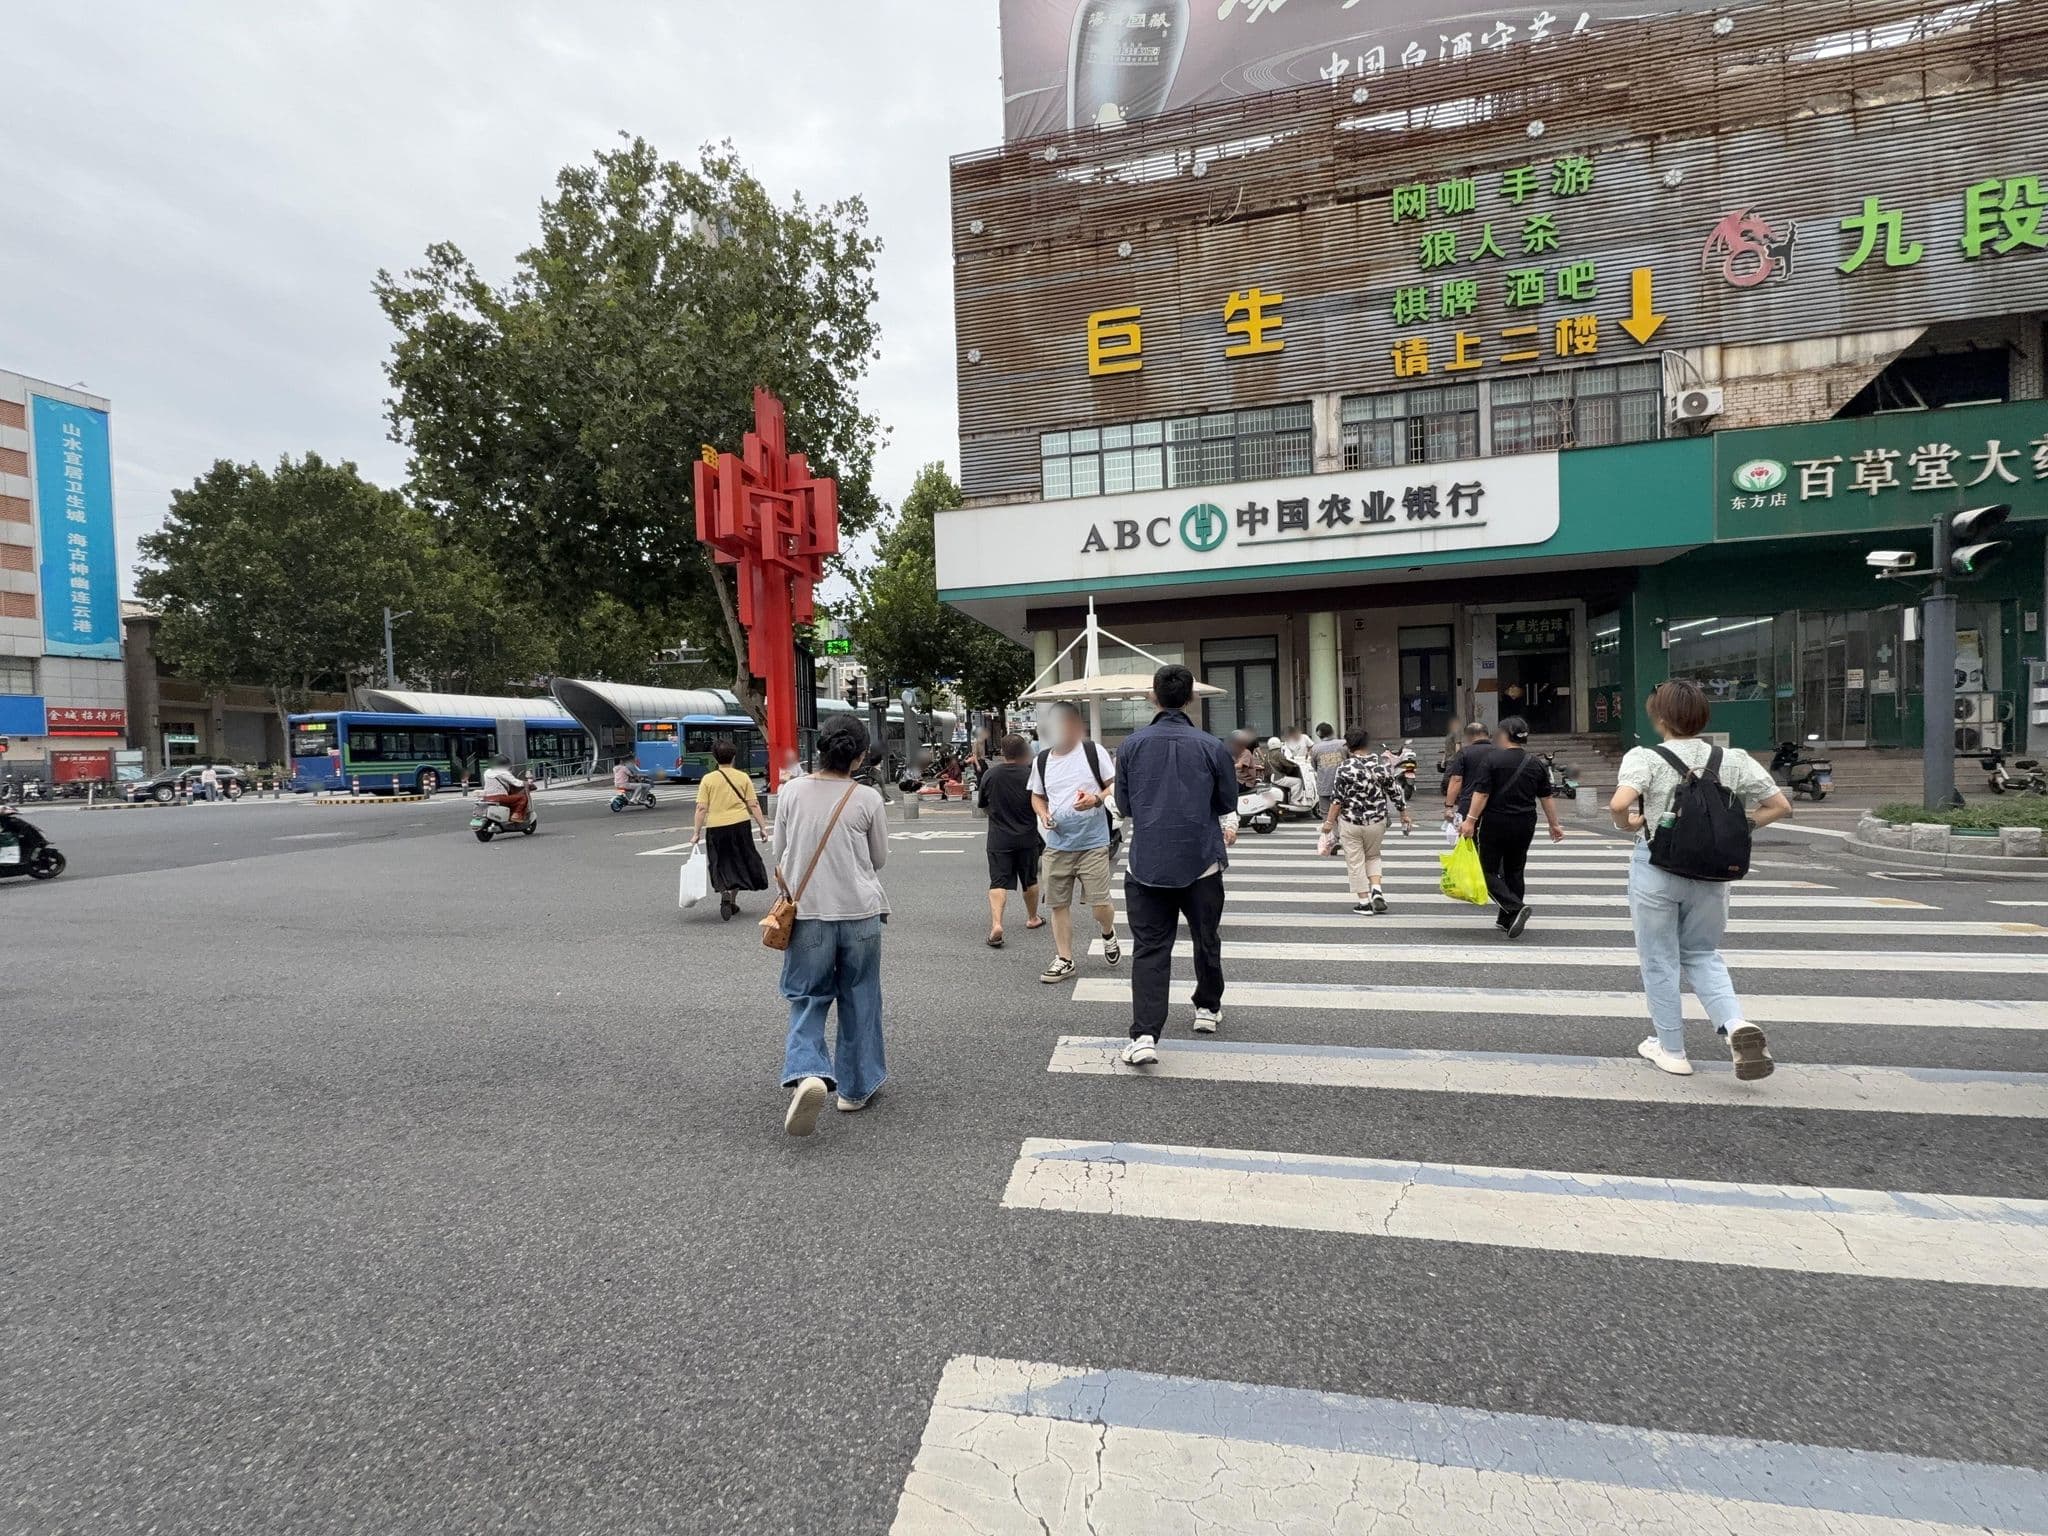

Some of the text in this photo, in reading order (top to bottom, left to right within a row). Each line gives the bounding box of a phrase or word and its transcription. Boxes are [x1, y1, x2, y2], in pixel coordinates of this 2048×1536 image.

[1392, 156, 1595, 224] 网咖 手游
[1419, 212, 1561, 270] 狼人杀
[1392, 260, 1599, 326] 棋牌 酒吧
[1391, 313, 1599, 378] 请上二楼
[1081, 480, 1487, 554] ABC 中国农业银行
[1730, 492, 1788, 511] 东方店
